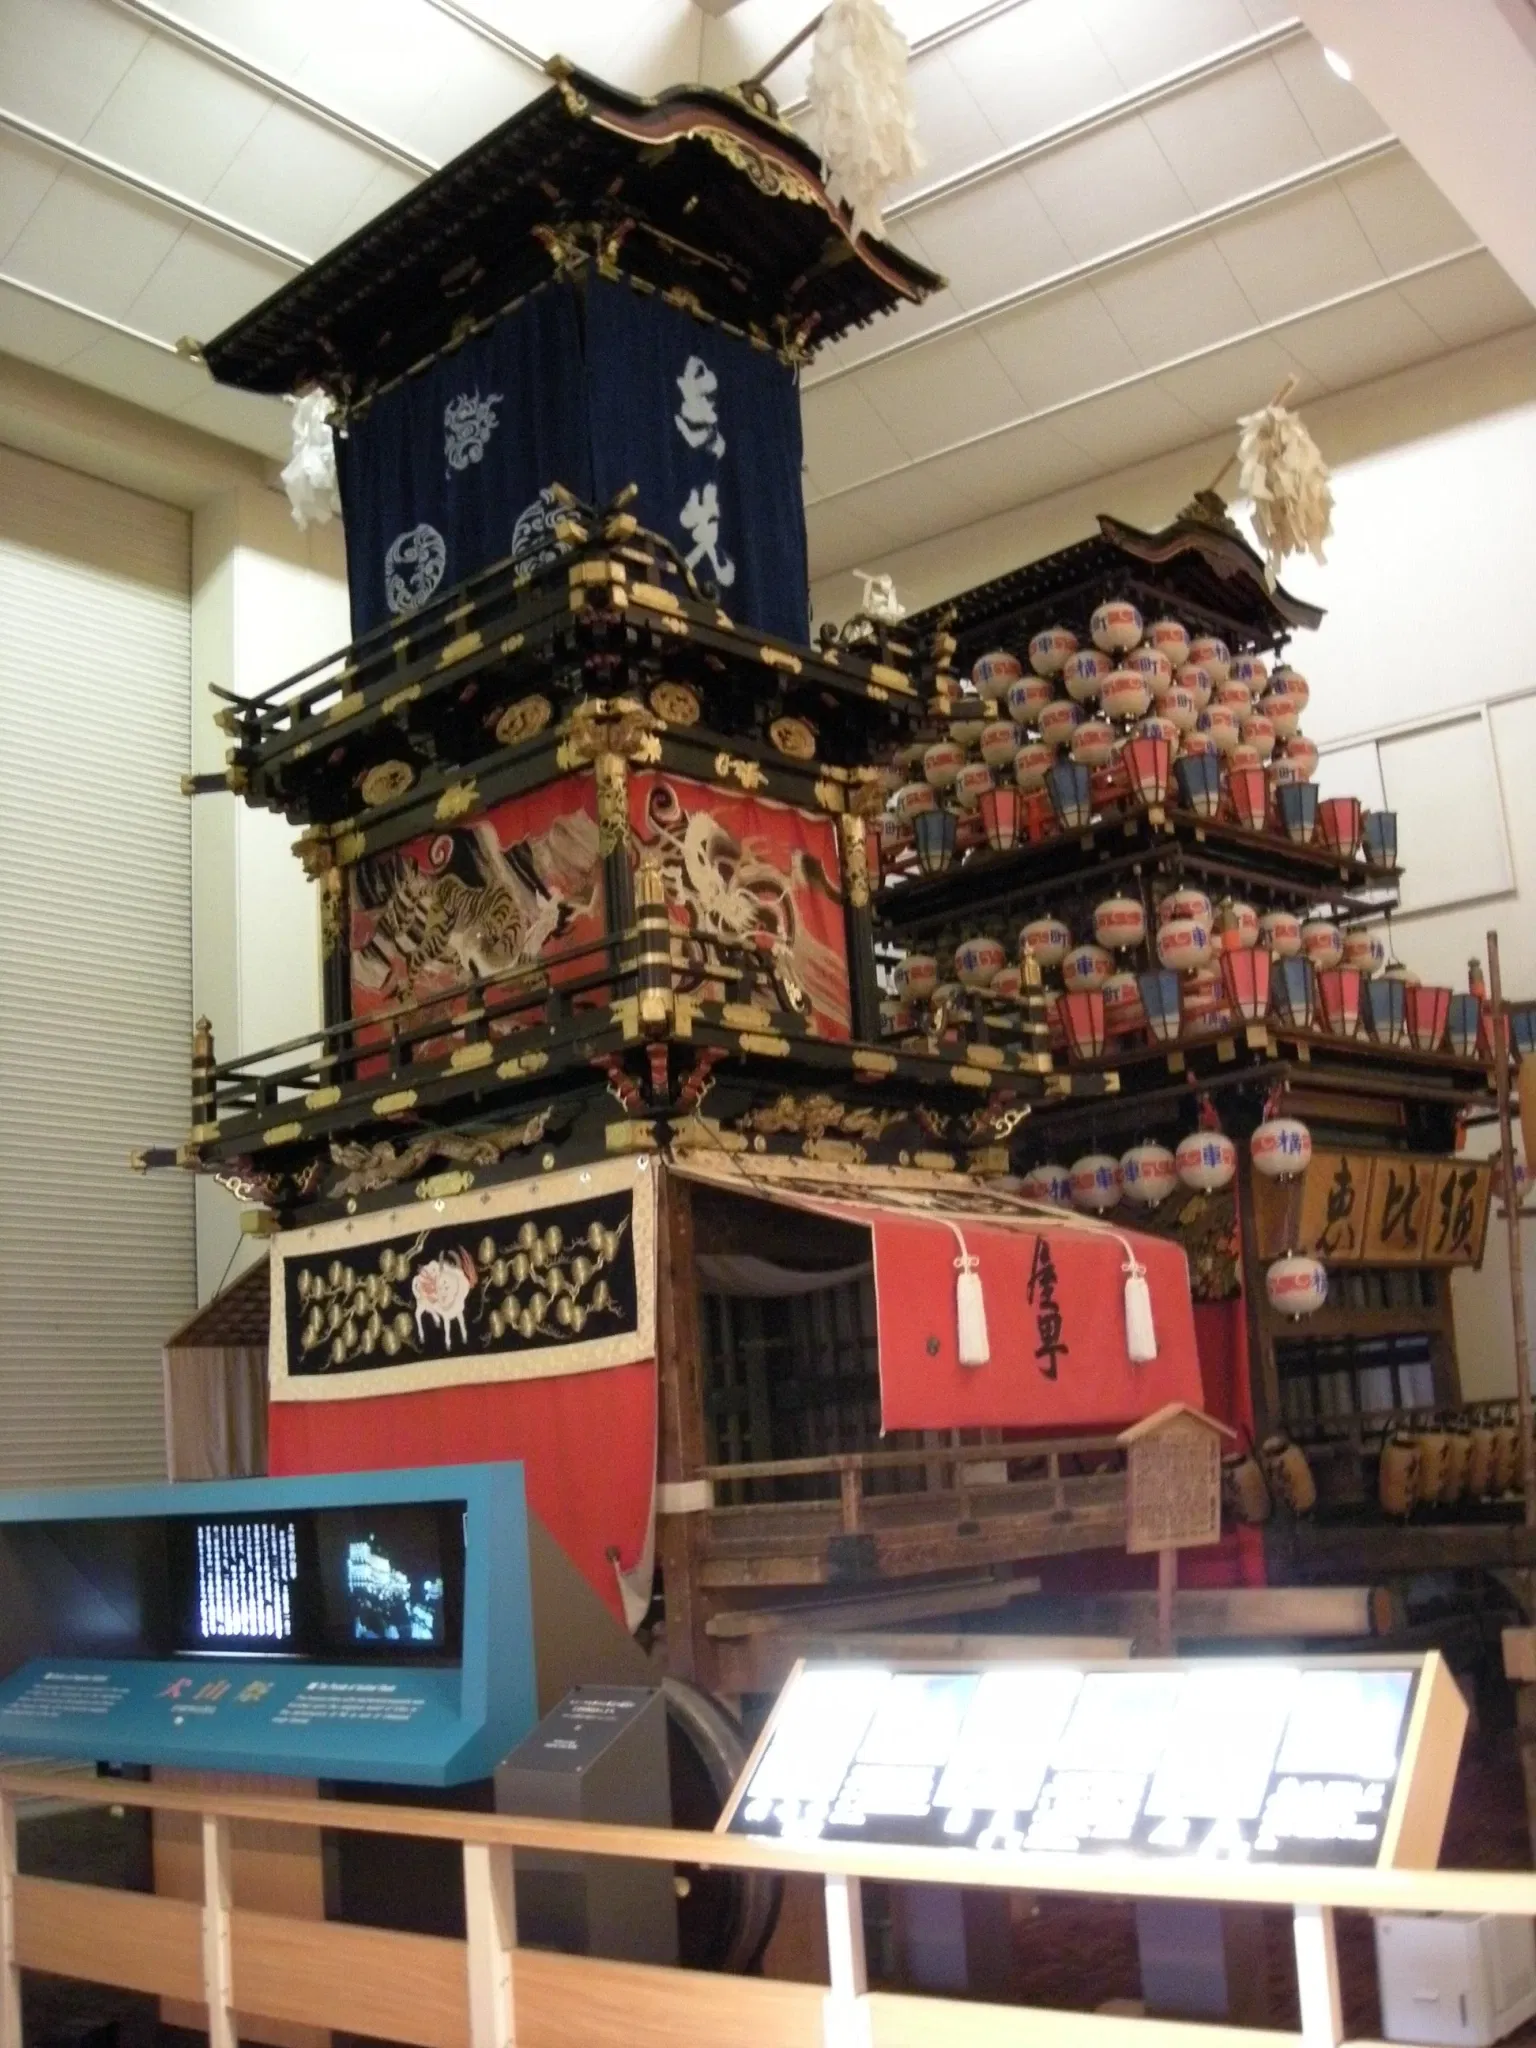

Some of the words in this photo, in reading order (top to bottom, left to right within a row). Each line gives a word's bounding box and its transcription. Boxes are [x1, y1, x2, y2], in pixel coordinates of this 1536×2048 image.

[1277, 1129, 1301, 1155] 横
[1202, 1142, 1221, 1169] 車
[1095, 1166, 1113, 1189] 車
